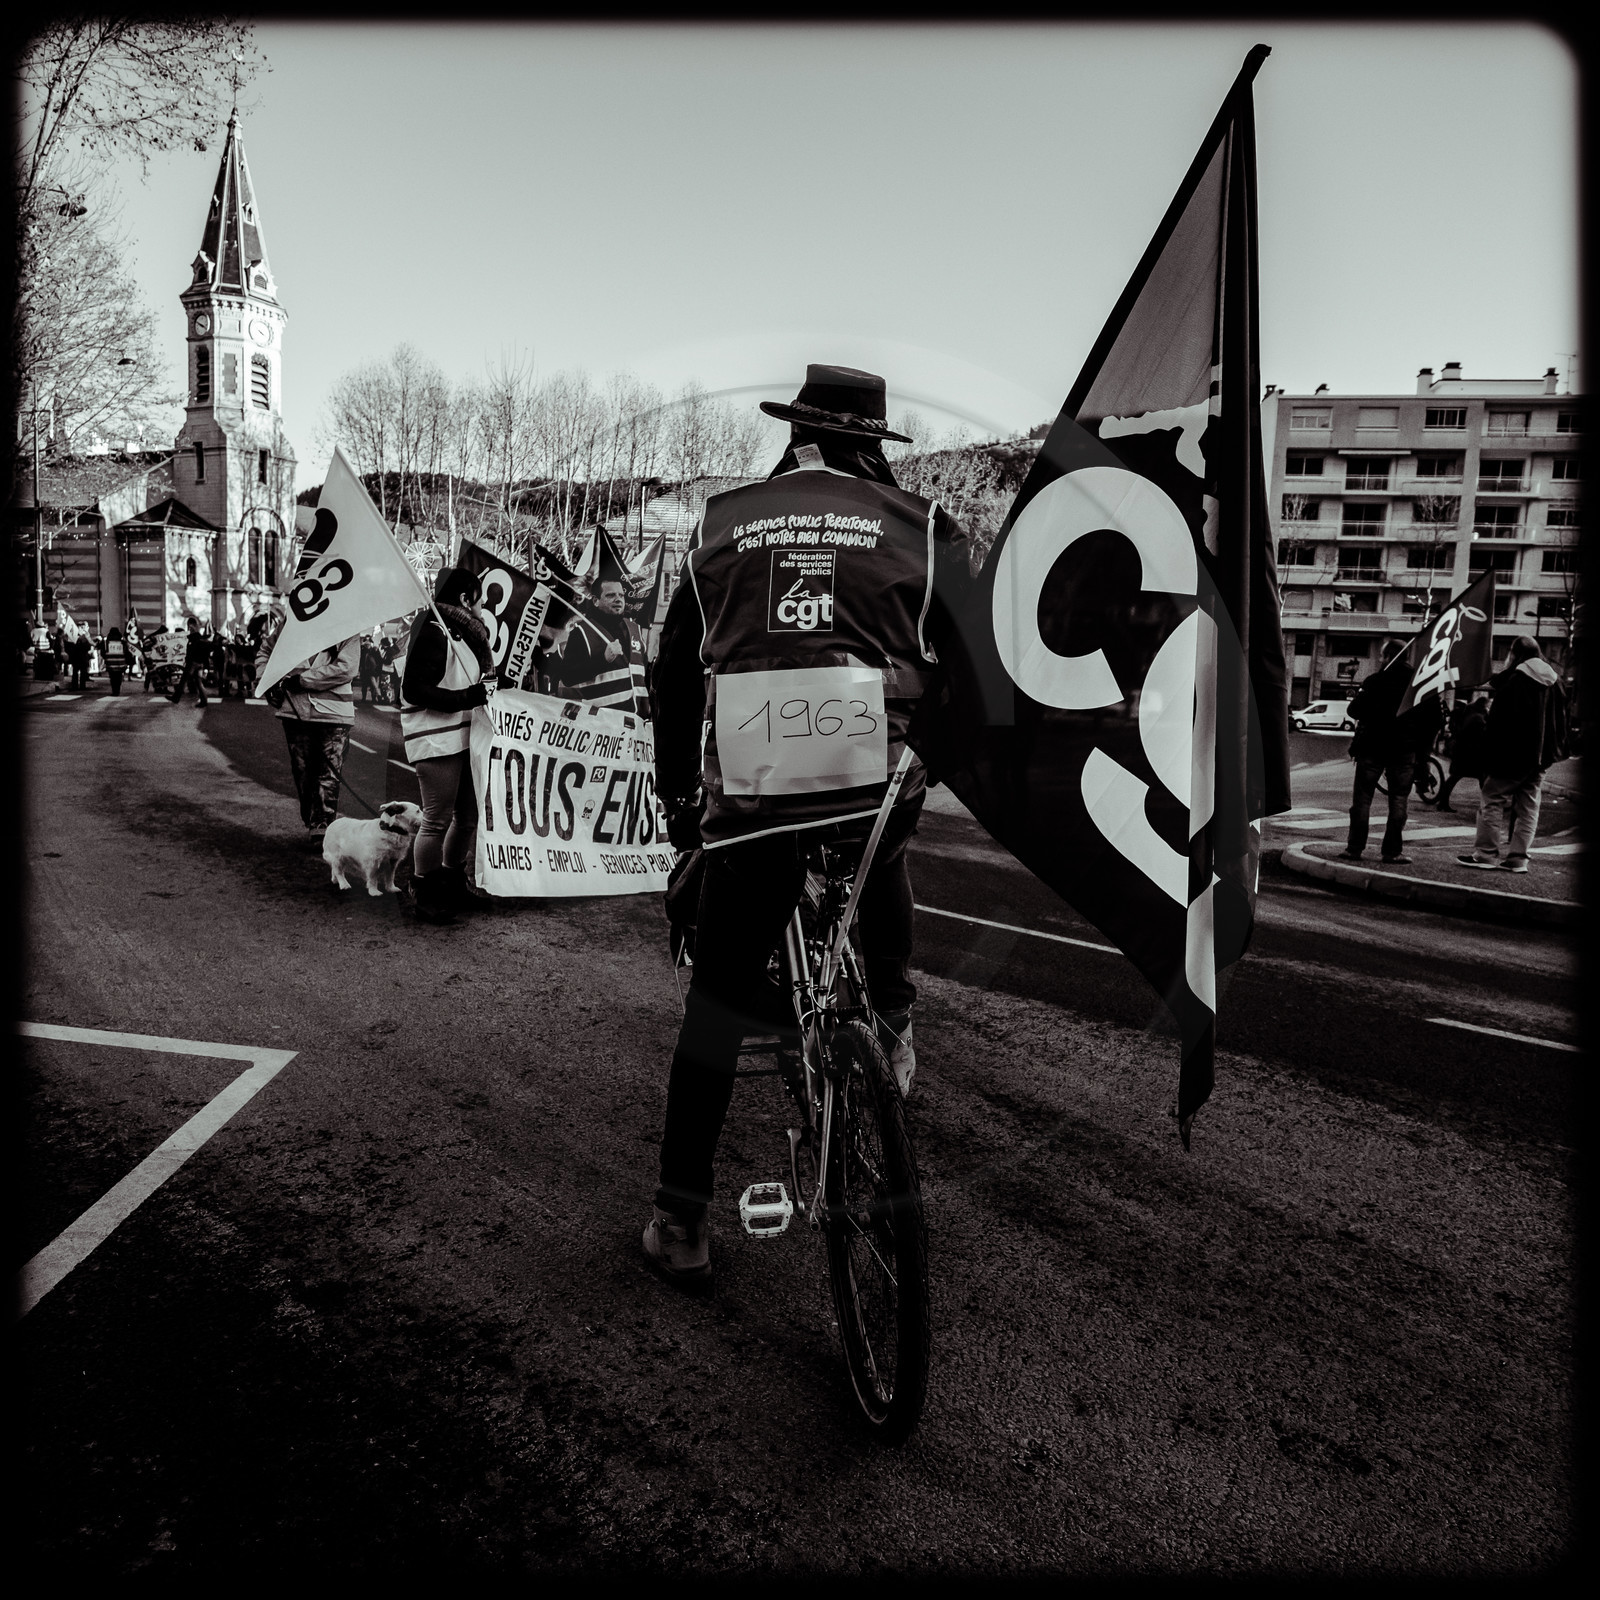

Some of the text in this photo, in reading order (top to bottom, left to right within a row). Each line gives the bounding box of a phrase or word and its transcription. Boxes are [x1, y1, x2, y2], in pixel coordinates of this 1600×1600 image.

[733, 513, 884, 540] LE SERVICE PUBLIC TERRITORIAL,
[737, 529, 878, 553] C'EST NOTRE BIEN COMMUN
[779, 560, 833, 568] des services
[787, 552, 833, 561] fédération
[800, 567, 832, 577] publics
[777, 594, 833, 630] cgt
[738, 699, 877, 743] 1963
[485, 746, 587, 841] TOUS
[546, 849, 588, 874] EMPLOI
[599, 853, 648, 875] SERVICES
